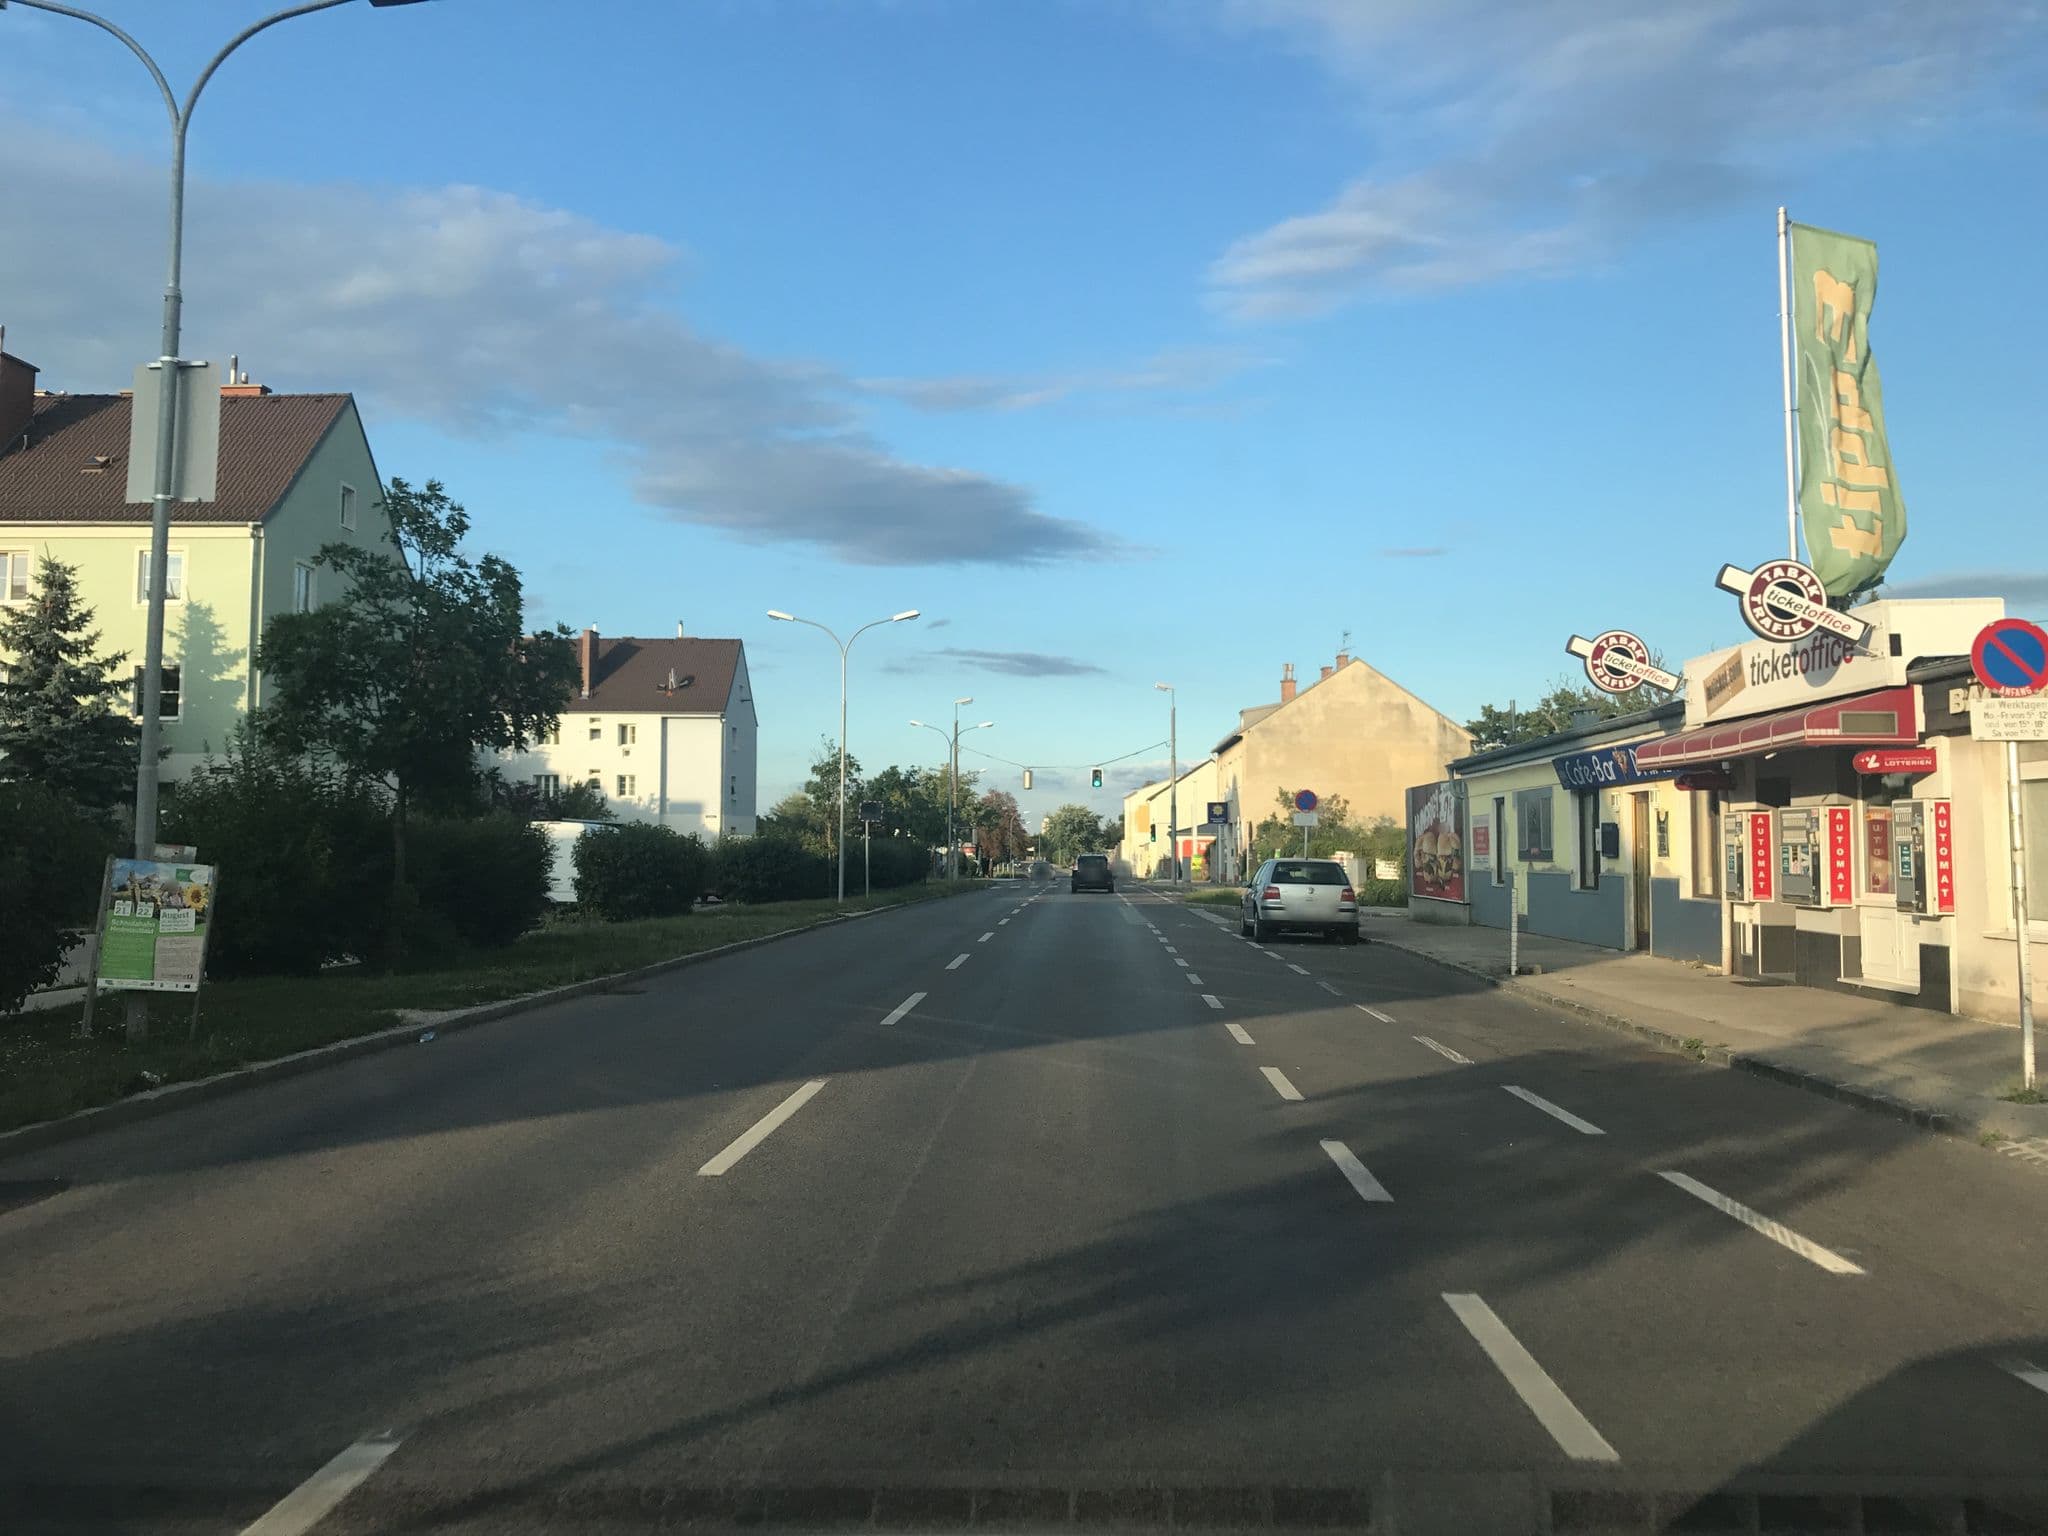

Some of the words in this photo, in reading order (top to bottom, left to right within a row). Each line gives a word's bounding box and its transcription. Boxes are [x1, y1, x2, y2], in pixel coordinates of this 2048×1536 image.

[1760, 566, 1820, 596] TABAK
[1750, 594, 1807, 635] TRAFIK
[1766, 588, 1852, 633] ticketoffice
[1599, 636, 1644, 658] TABAK
[1750, 635, 1855, 686] ticketoffice
[1593, 659, 1635, 688] TRAFIK
[1604, 653, 1670, 685] ticketoffice
[1998, 685, 2033, 697] ANFANG
[1884, 759, 1932, 767] LOTTERIEN
[1757, 817, 1766, 889] AUTOMAT
[1835, 812, 1845, 892] AUTOMAT
[1938, 805, 1950, 898] AUTOMAT
